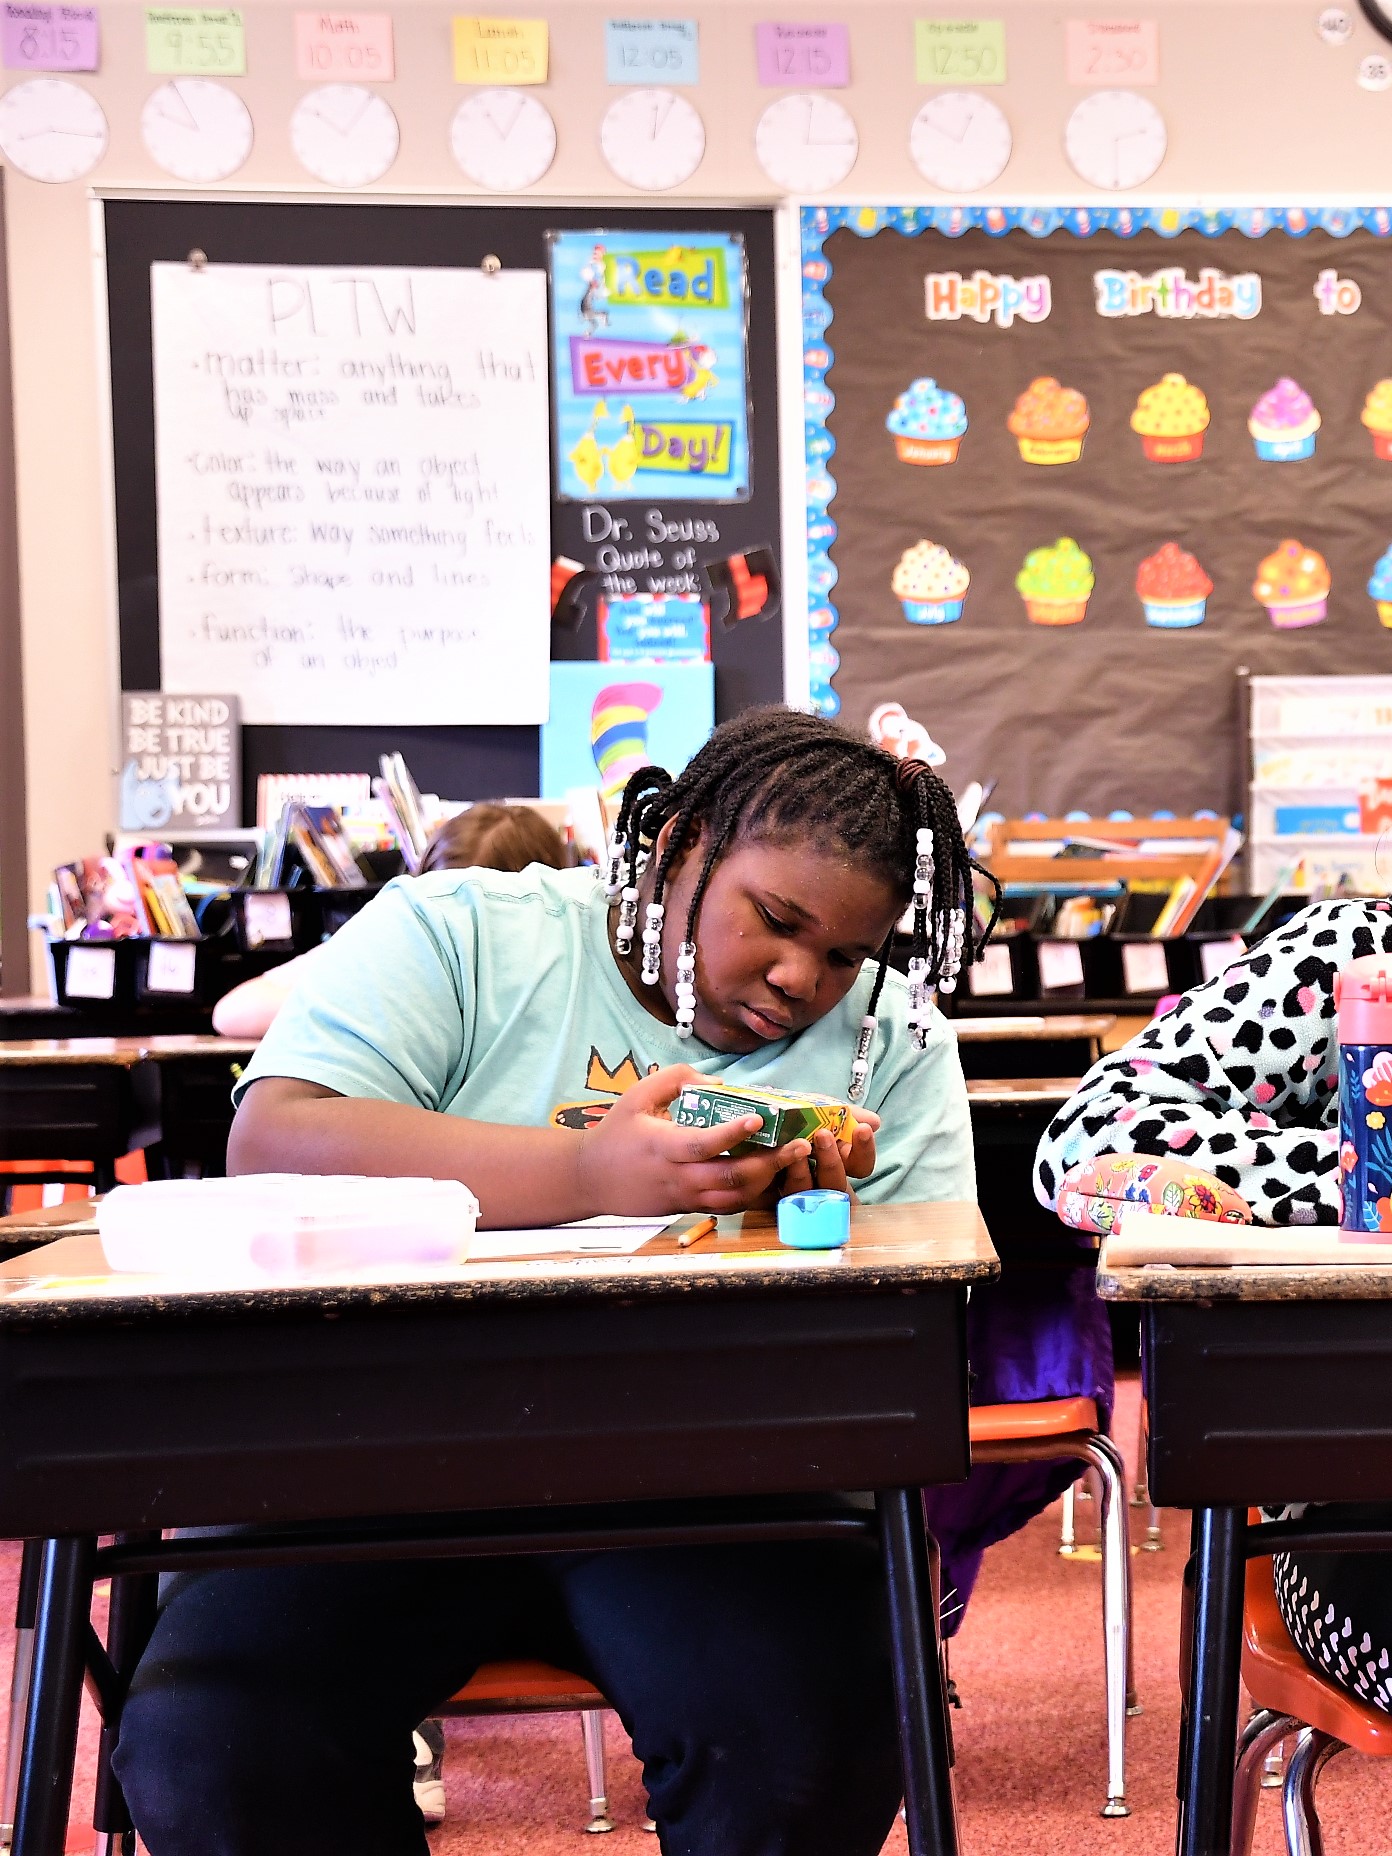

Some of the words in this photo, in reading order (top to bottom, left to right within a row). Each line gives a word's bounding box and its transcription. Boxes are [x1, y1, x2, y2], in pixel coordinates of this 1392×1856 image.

[614, 255, 715, 303] Read
[266, 276, 418, 337] PLTW
[928, 275, 1050, 323] Happy
[1098, 271, 1260, 317] Birthday
[1317, 272, 1360, 312] to
[478, 350, 538, 383] that
[583, 347, 688, 388] Every
[223, 381, 268, 406] has
[288, 389, 340, 405] mass
[363, 385, 398, 405] and
[641, 422, 724, 472] Day!
[264, 449, 297, 475] the
[316, 459, 361, 485] way
[582, 505, 633, 542] Dr.
[645, 508, 720, 543] Seuss
[372, 563, 415, 587] and
[596, 543, 664, 573] Quote
[671, 546, 697, 570] of
[601, 573, 638, 595] the
[130, 699, 163, 726] BE
[164, 698, 231, 727] KIND
[128, 726, 162, 753] BE
[164, 726, 232, 754] TRUE
[137, 754, 196, 781] JUST
[198, 754, 232, 781] BE
[164, 780, 232, 816] YOU
